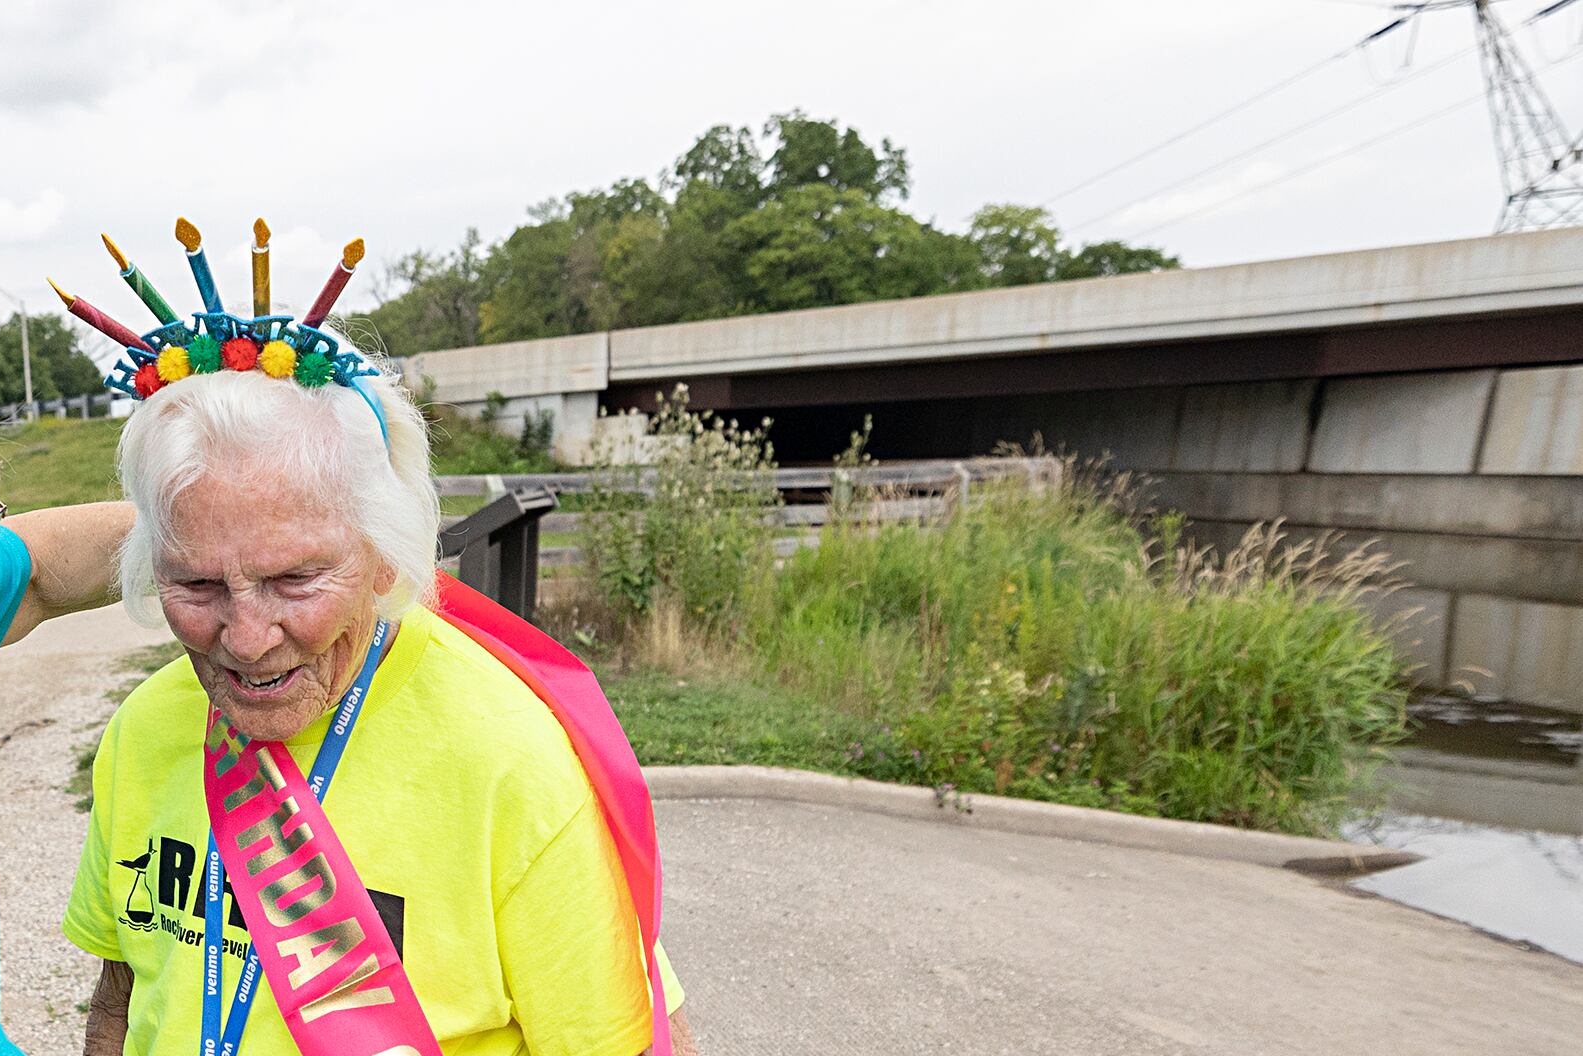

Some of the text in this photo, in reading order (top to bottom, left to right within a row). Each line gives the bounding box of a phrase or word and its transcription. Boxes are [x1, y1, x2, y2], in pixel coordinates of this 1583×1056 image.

[334, 687, 363, 736] venmo
[209, 851, 220, 902] venmo
[207, 945, 218, 996] venmo
[238, 954, 259, 1004] venmo
